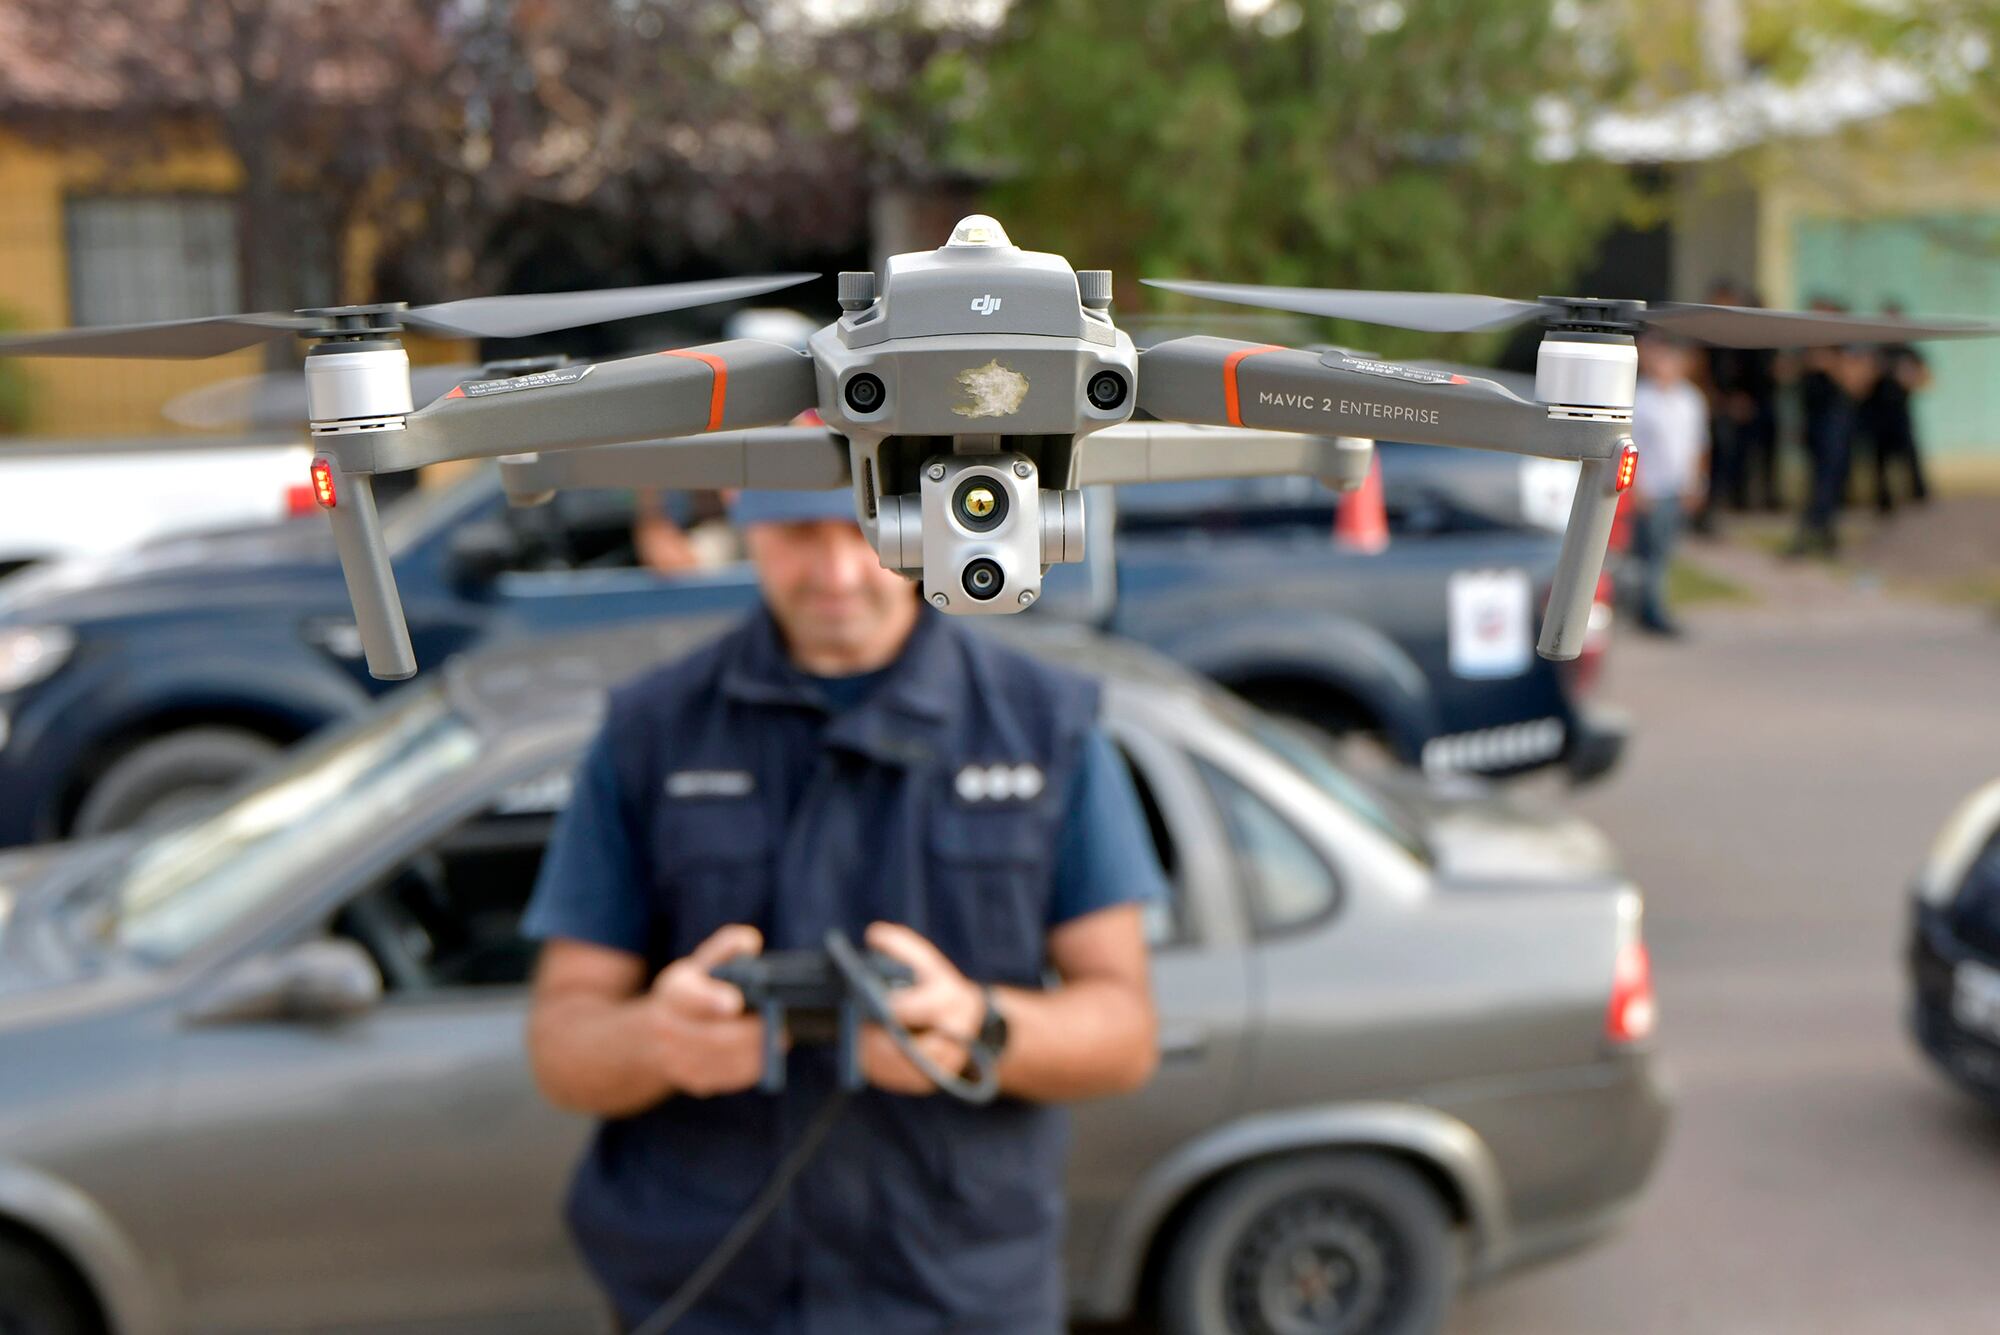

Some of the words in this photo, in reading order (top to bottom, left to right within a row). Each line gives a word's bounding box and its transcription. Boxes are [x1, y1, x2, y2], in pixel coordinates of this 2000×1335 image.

[515, 380, 528, 388] DO
[530, 378, 545, 386] NO
[545, 374, 577, 384] TOUCH
[1259, 391, 1314, 410] MAVIC
[1321, 398, 1332, 412] 2
[1339, 400, 1440, 425] ENTERPRISE
